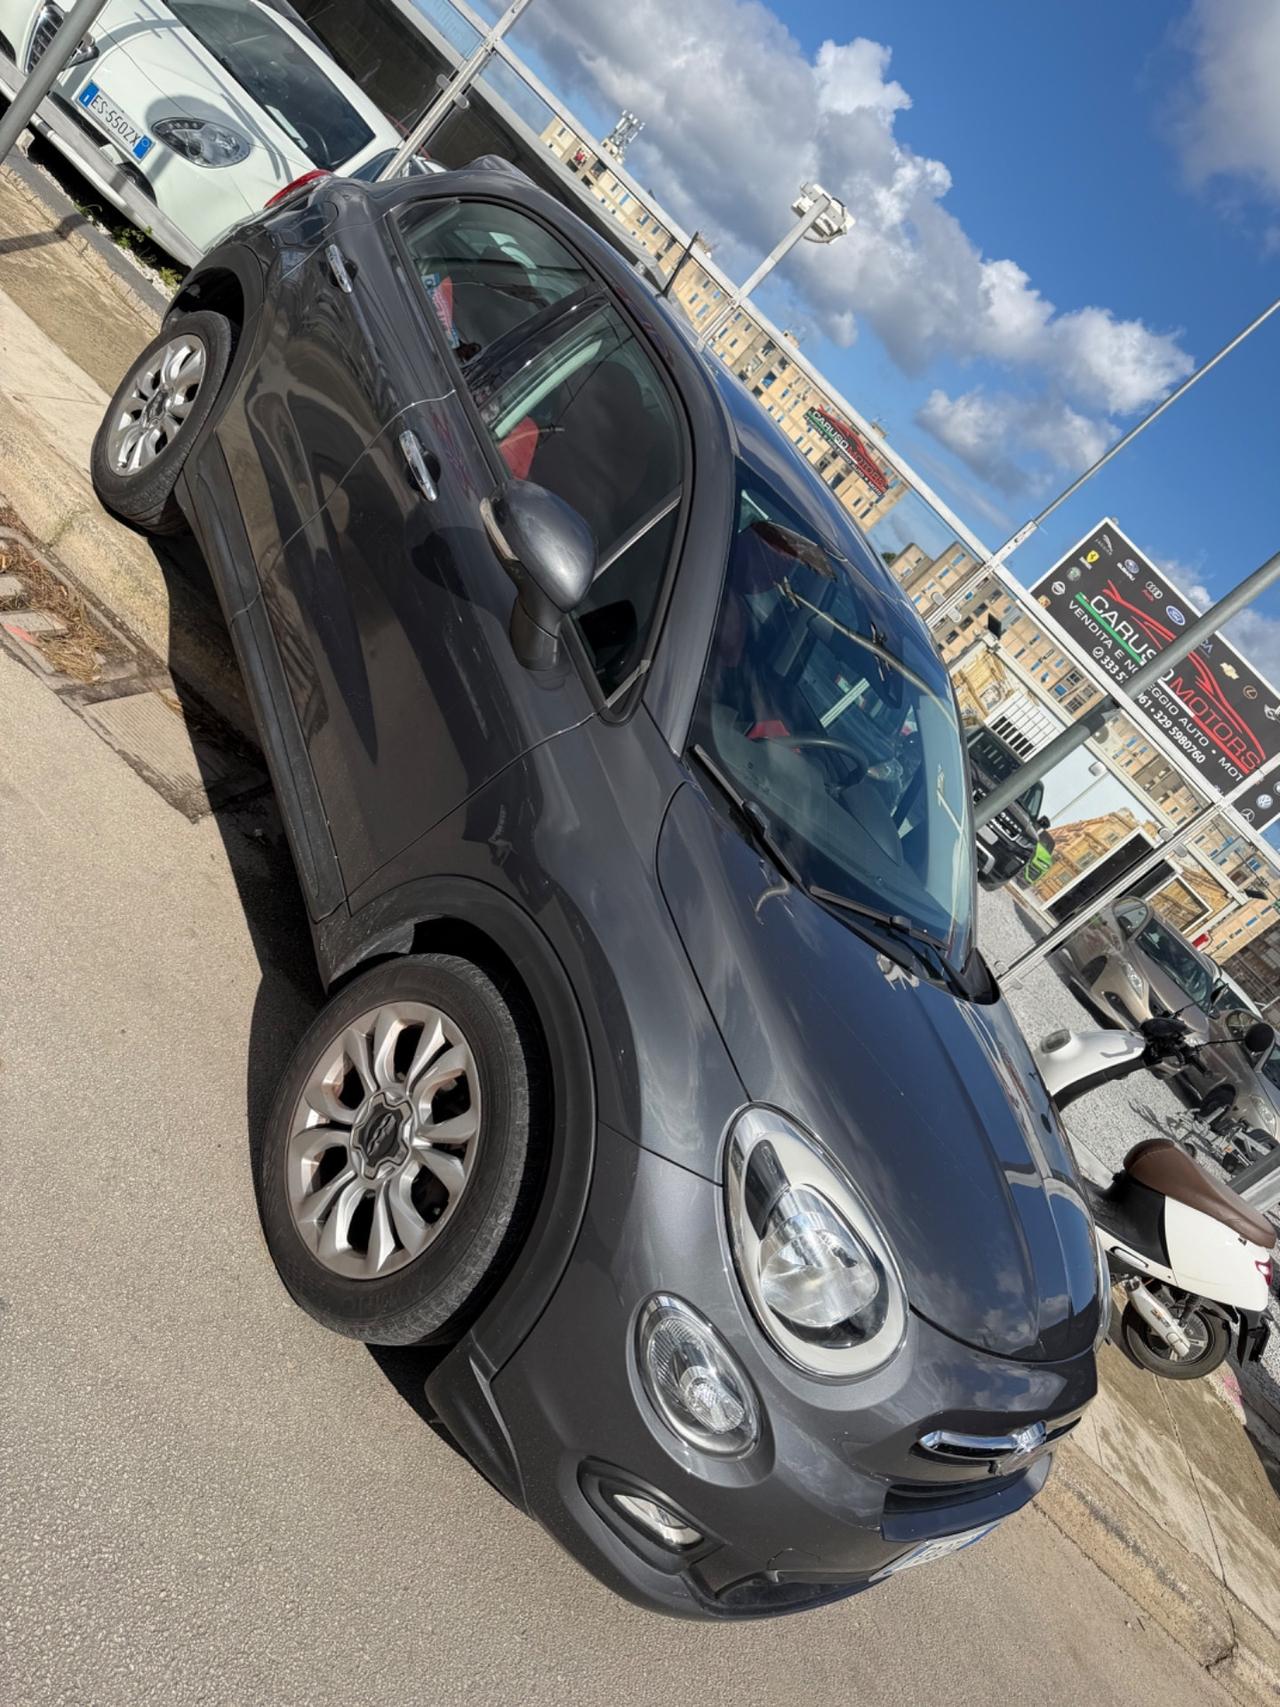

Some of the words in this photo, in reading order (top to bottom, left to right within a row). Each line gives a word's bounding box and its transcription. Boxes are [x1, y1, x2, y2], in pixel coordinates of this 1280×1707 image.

[813, 411, 848, 449] CARUSO
[1069, 600, 1113, 649] VENDITA
[1114, 649, 1126, 660] E
[1179, 717, 1210, 747] AUTO
[1101, 656, 1121, 675] 333
[1153, 709, 1173, 729] 329
[1168, 725, 1206, 764] 5980760
[1170, 676, 1261, 770] MOTORS
